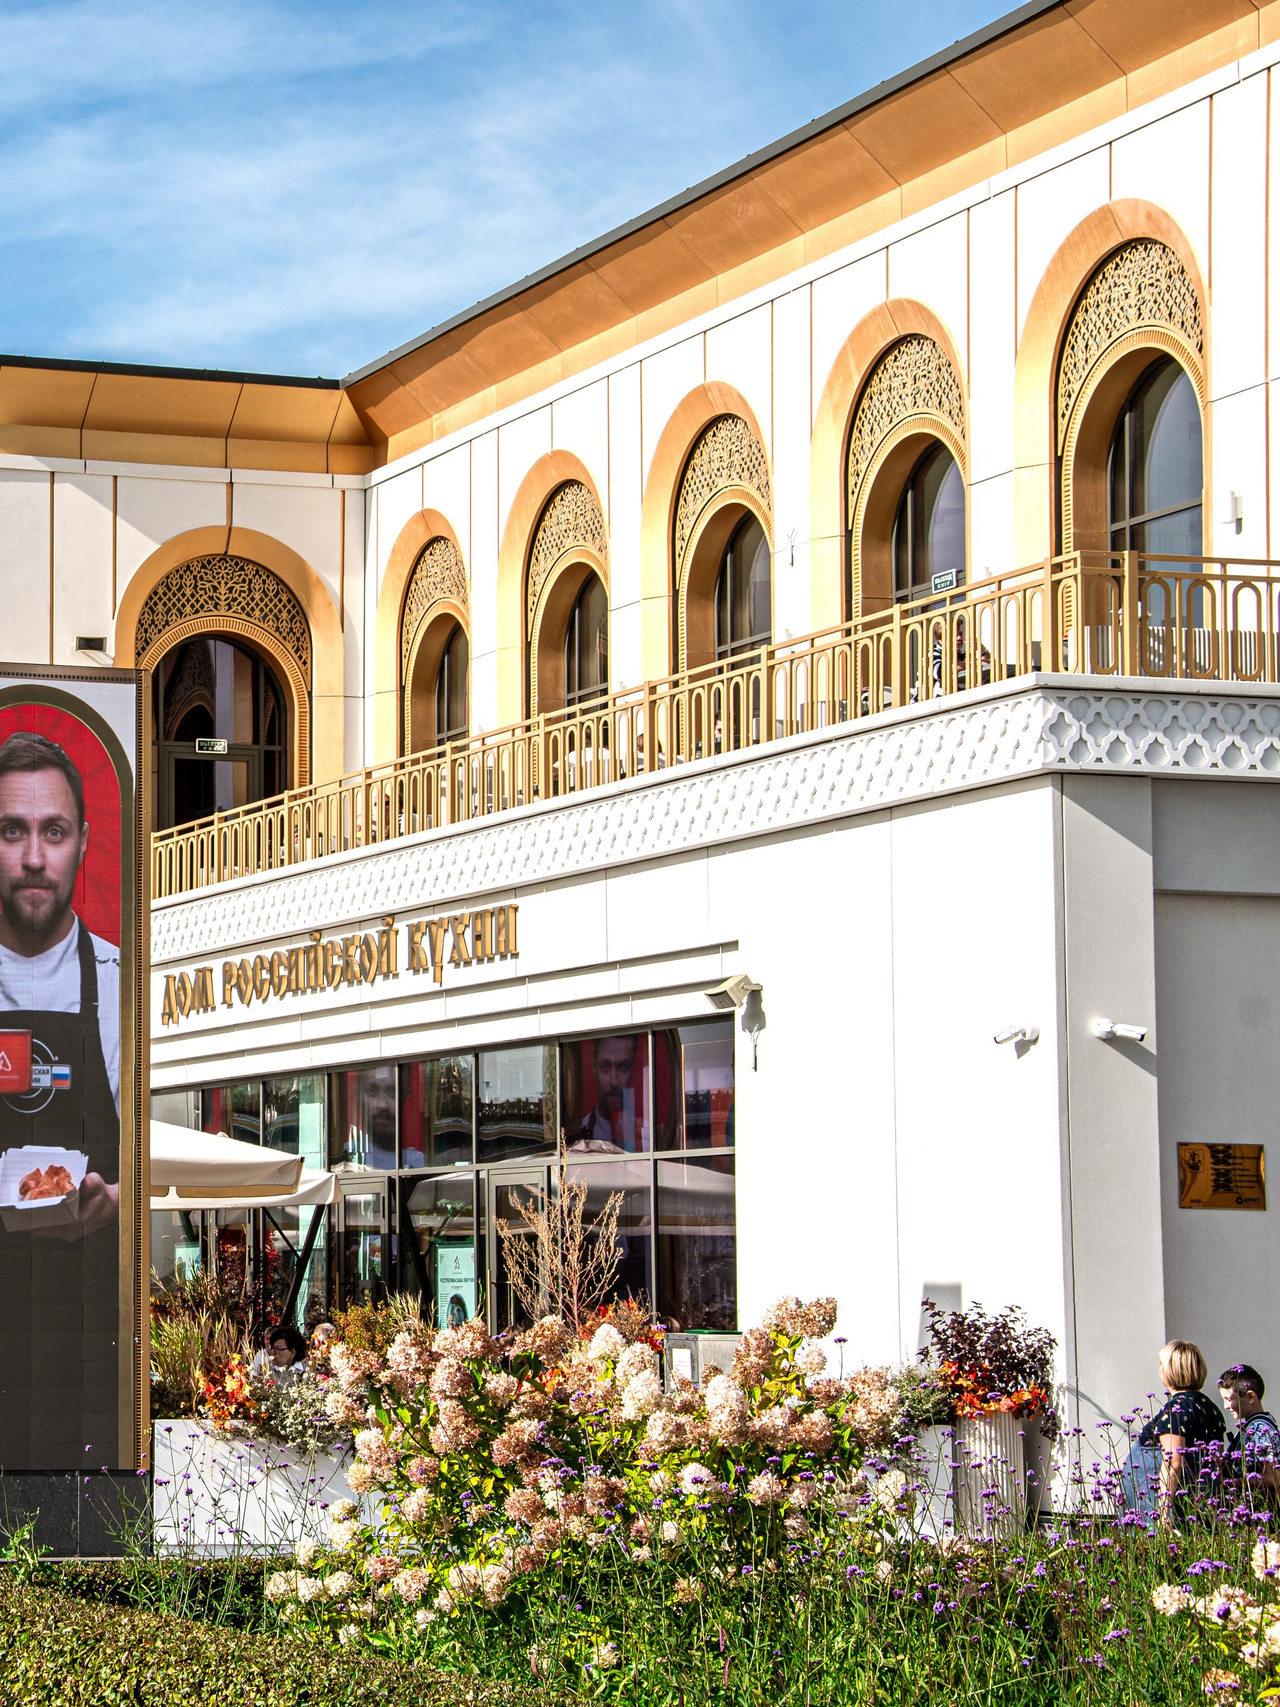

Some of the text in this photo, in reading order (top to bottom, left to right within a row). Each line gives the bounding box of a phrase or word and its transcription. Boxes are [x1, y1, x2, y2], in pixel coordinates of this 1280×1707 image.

[161, 904, 520, 1026] ДОМ РОССИЙСКОЙ КУХНИ
